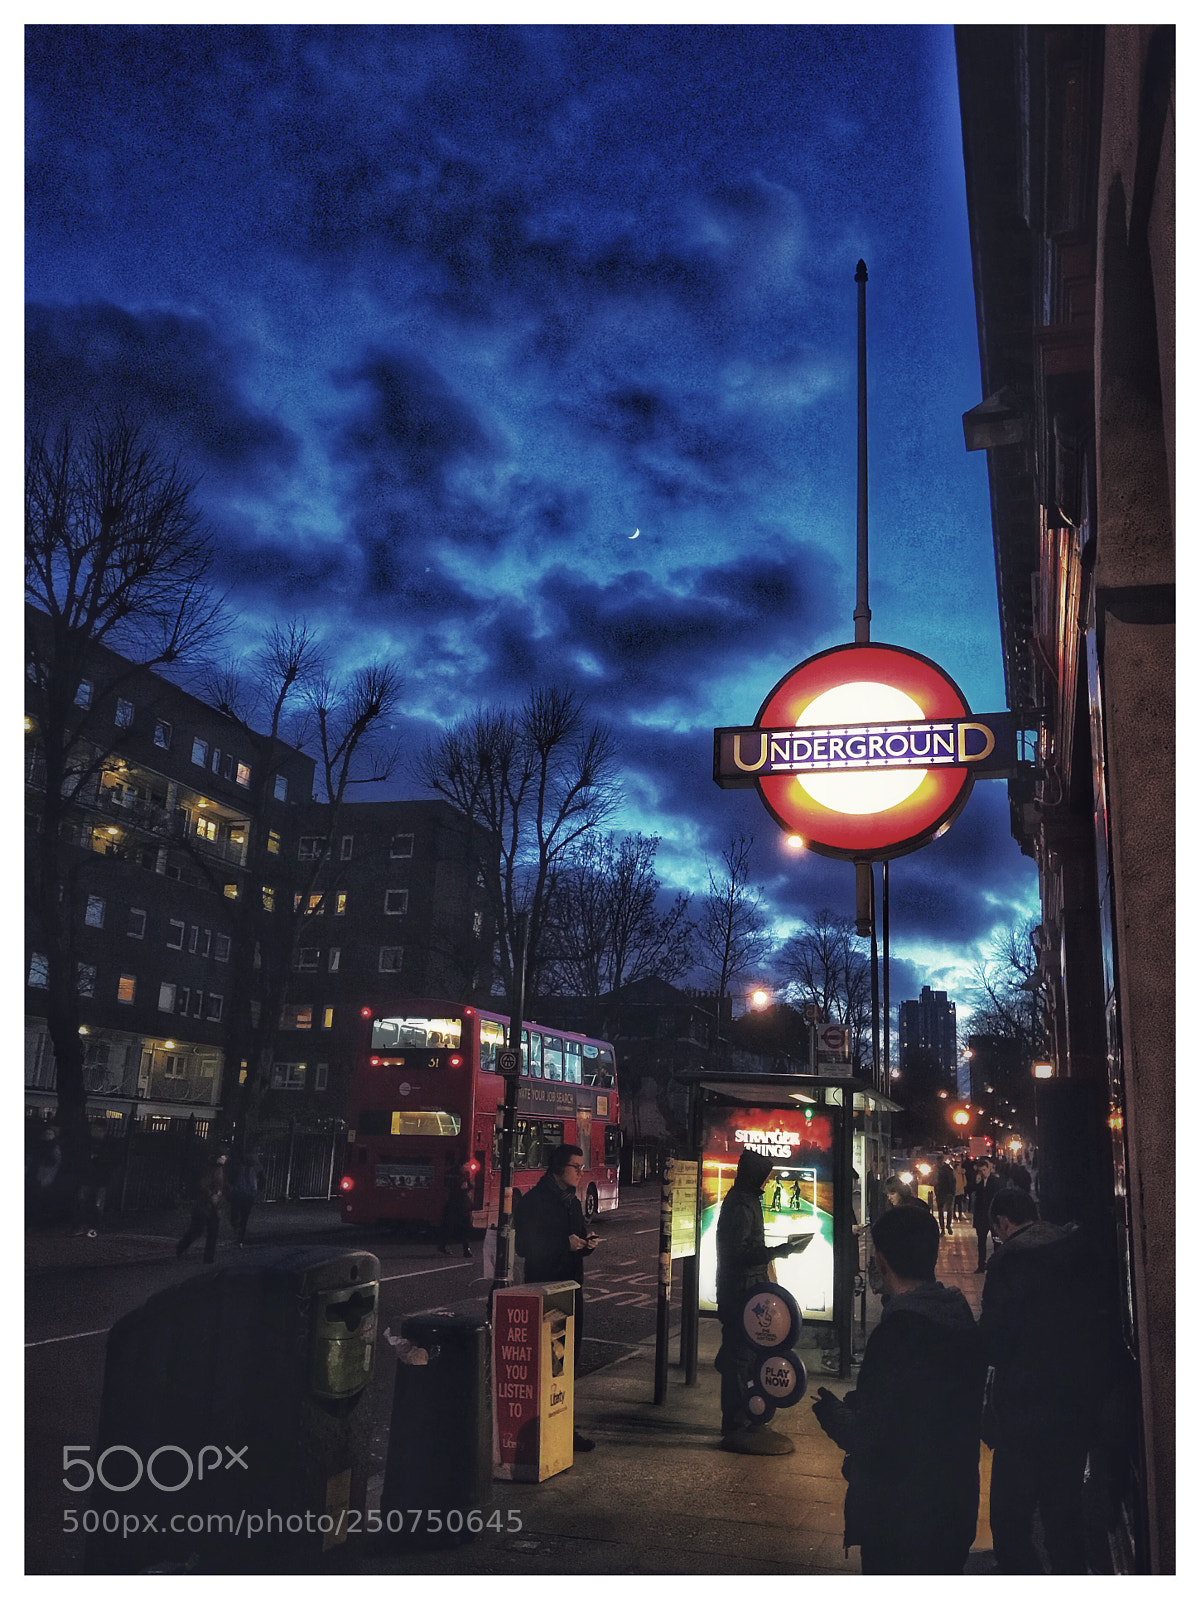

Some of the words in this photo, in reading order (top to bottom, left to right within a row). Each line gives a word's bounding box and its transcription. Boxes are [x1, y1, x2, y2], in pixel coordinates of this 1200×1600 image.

[733, 722, 996, 772] UNDERGROUND
[532, 1088, 546, 1101] YOUR
[546, 1091, 557, 1103] JOB
[556, 1091, 574, 1104] SEARCH
[735, 1129, 801, 1146] STRANGER
[744, 1143, 792, 1158] THINGS
[507, 1308, 529, 1324] YOU
[507, 1327, 528, 1342] ARE
[501, 1345, 532, 1361] WHAT
[505, 1364, 528, 1380] YOU
[765, 1367, 790, 1379] PLAY
[765, 1376, 790, 1388] NOW
[498, 1383, 533, 1399] LISTEN
[508, 1402, 522, 1418] TO
